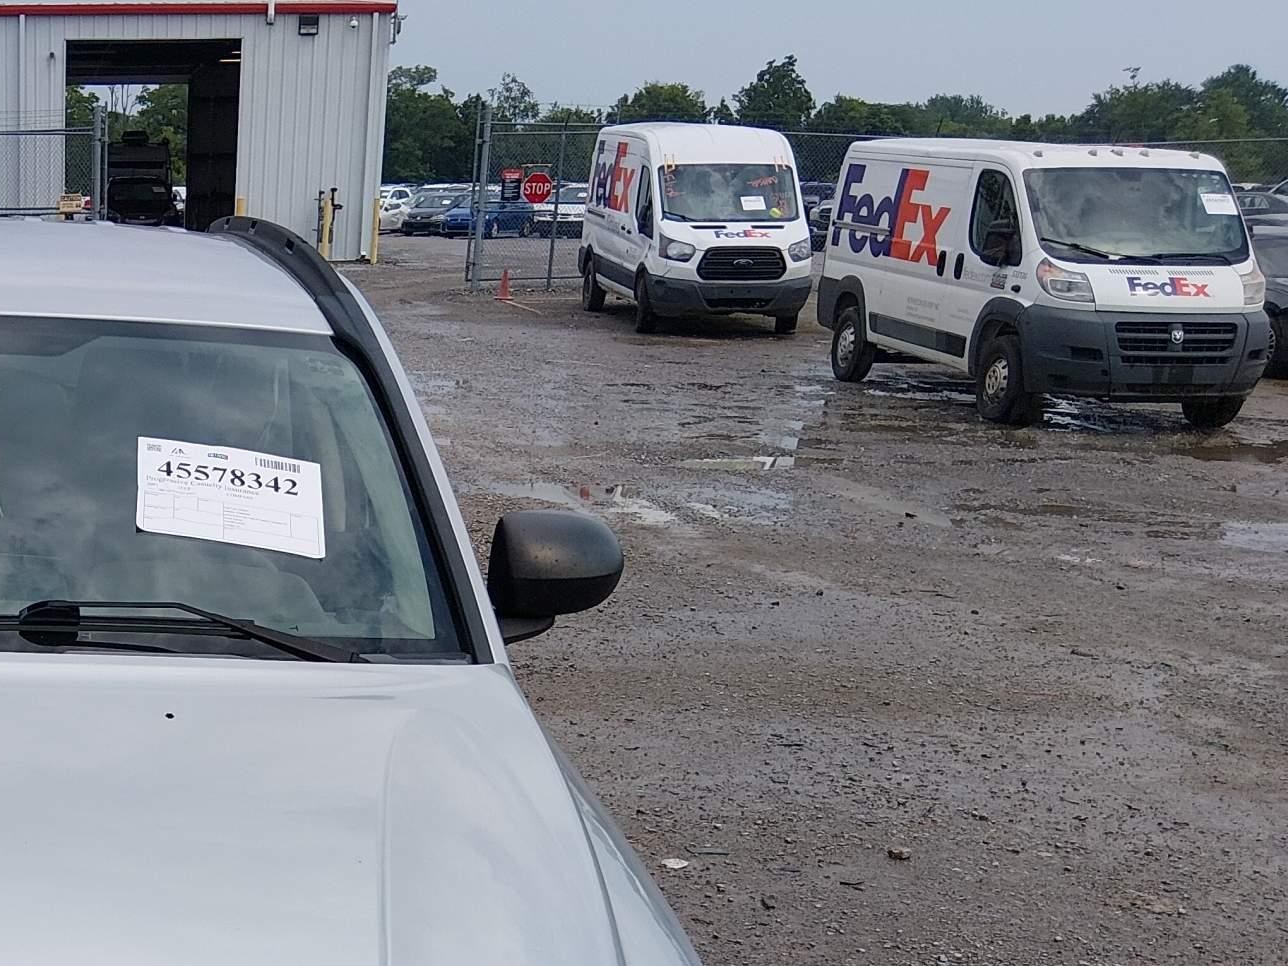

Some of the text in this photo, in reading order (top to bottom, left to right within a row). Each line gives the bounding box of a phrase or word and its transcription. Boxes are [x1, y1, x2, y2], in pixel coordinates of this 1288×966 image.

[524, 182, 551, 195] STOP
[831, 163, 952, 267] FedEx
[713, 229, 772, 239] FedEx
[1126, 276, 1212, 297] FedEx
[157, 460, 299, 496] 45578342
